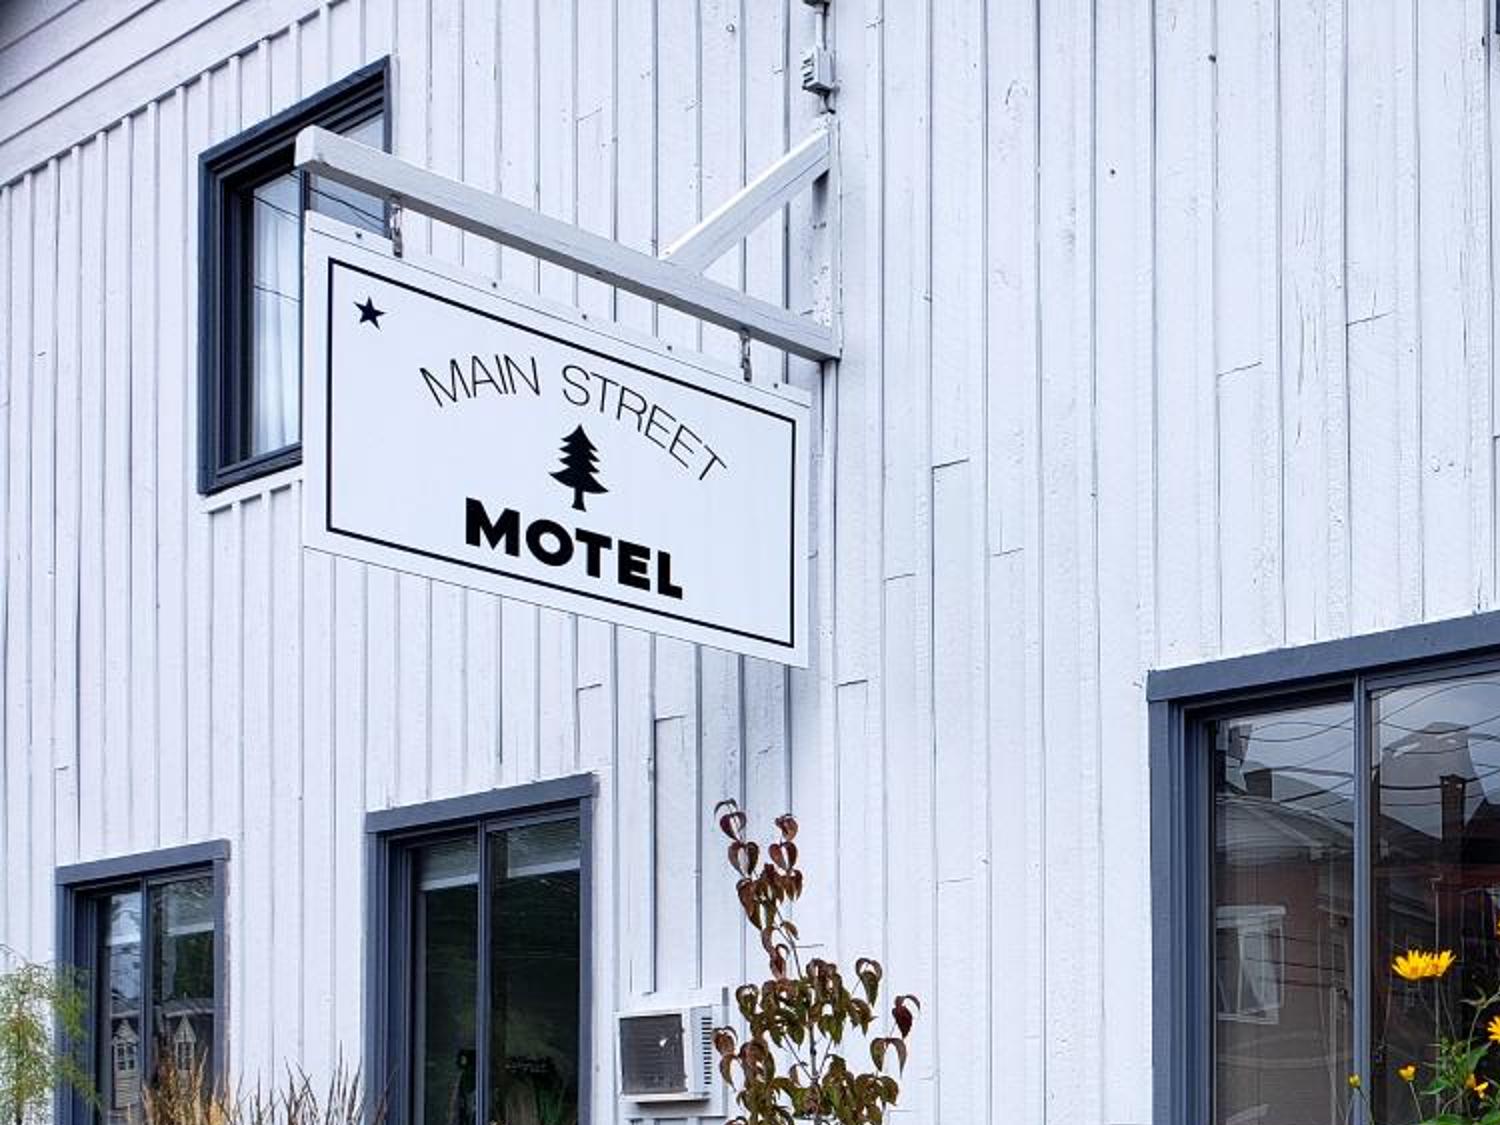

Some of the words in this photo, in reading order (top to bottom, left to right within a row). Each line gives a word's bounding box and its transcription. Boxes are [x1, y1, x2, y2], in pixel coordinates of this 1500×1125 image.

[420, 354, 541, 407] MAIN
[561, 364, 728, 481] STREET
[466, 497, 683, 600] MOTEL
